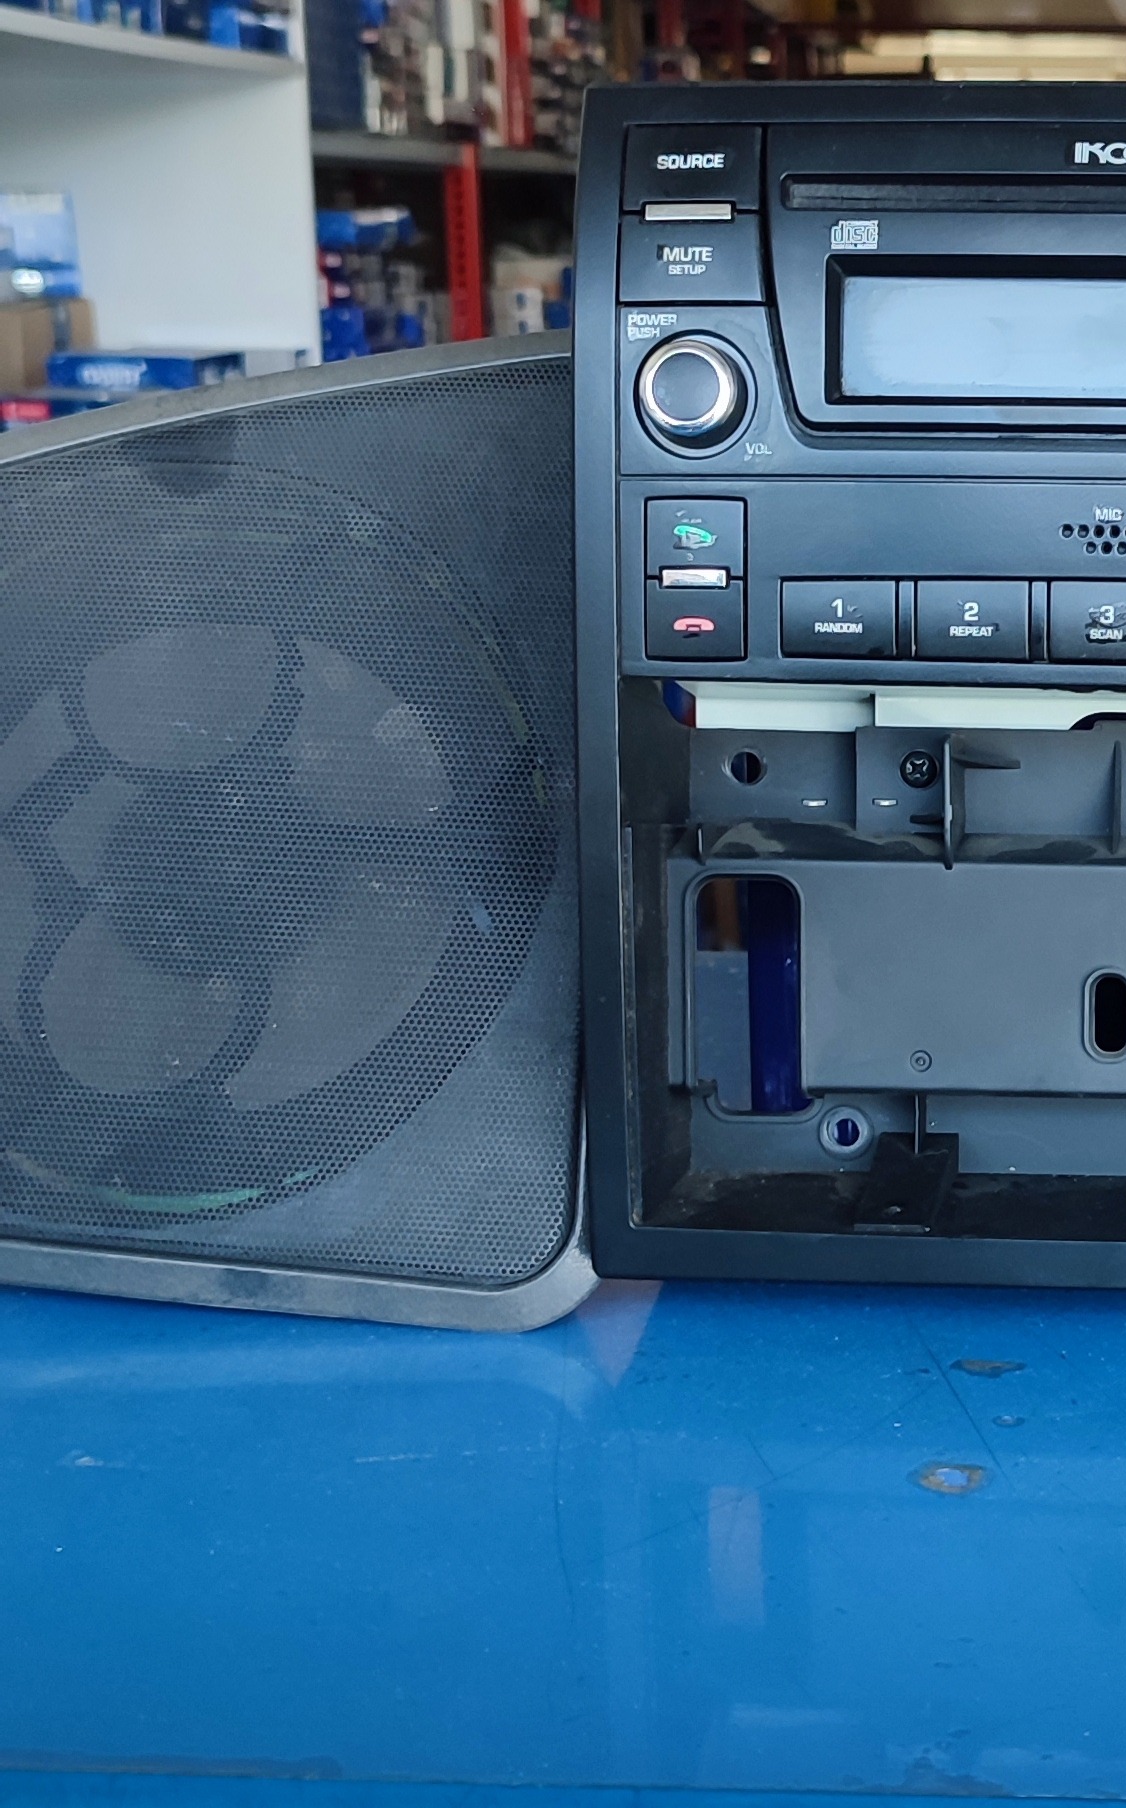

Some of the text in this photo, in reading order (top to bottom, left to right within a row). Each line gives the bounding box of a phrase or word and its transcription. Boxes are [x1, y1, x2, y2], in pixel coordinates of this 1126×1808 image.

[656, 154, 725, 170] SOURCE
[663, 246, 713, 263] MUTE
[668, 264, 706, 275] SETUP
[627, 314, 677, 326] POWER
[627, 327, 660, 338] PUSH
[745, 442, 773, 455] VOL
[1096, 507, 1122, 521] MIC
[830, 599, 843, 618] 1
[963, 602, 979, 621] 2
[1100, 605, 1115, 624] 3
[814, 623, 863, 634] RANDOM
[950, 625, 994, 637] REPEAT
[1089, 629, 1123, 640] SCAN
